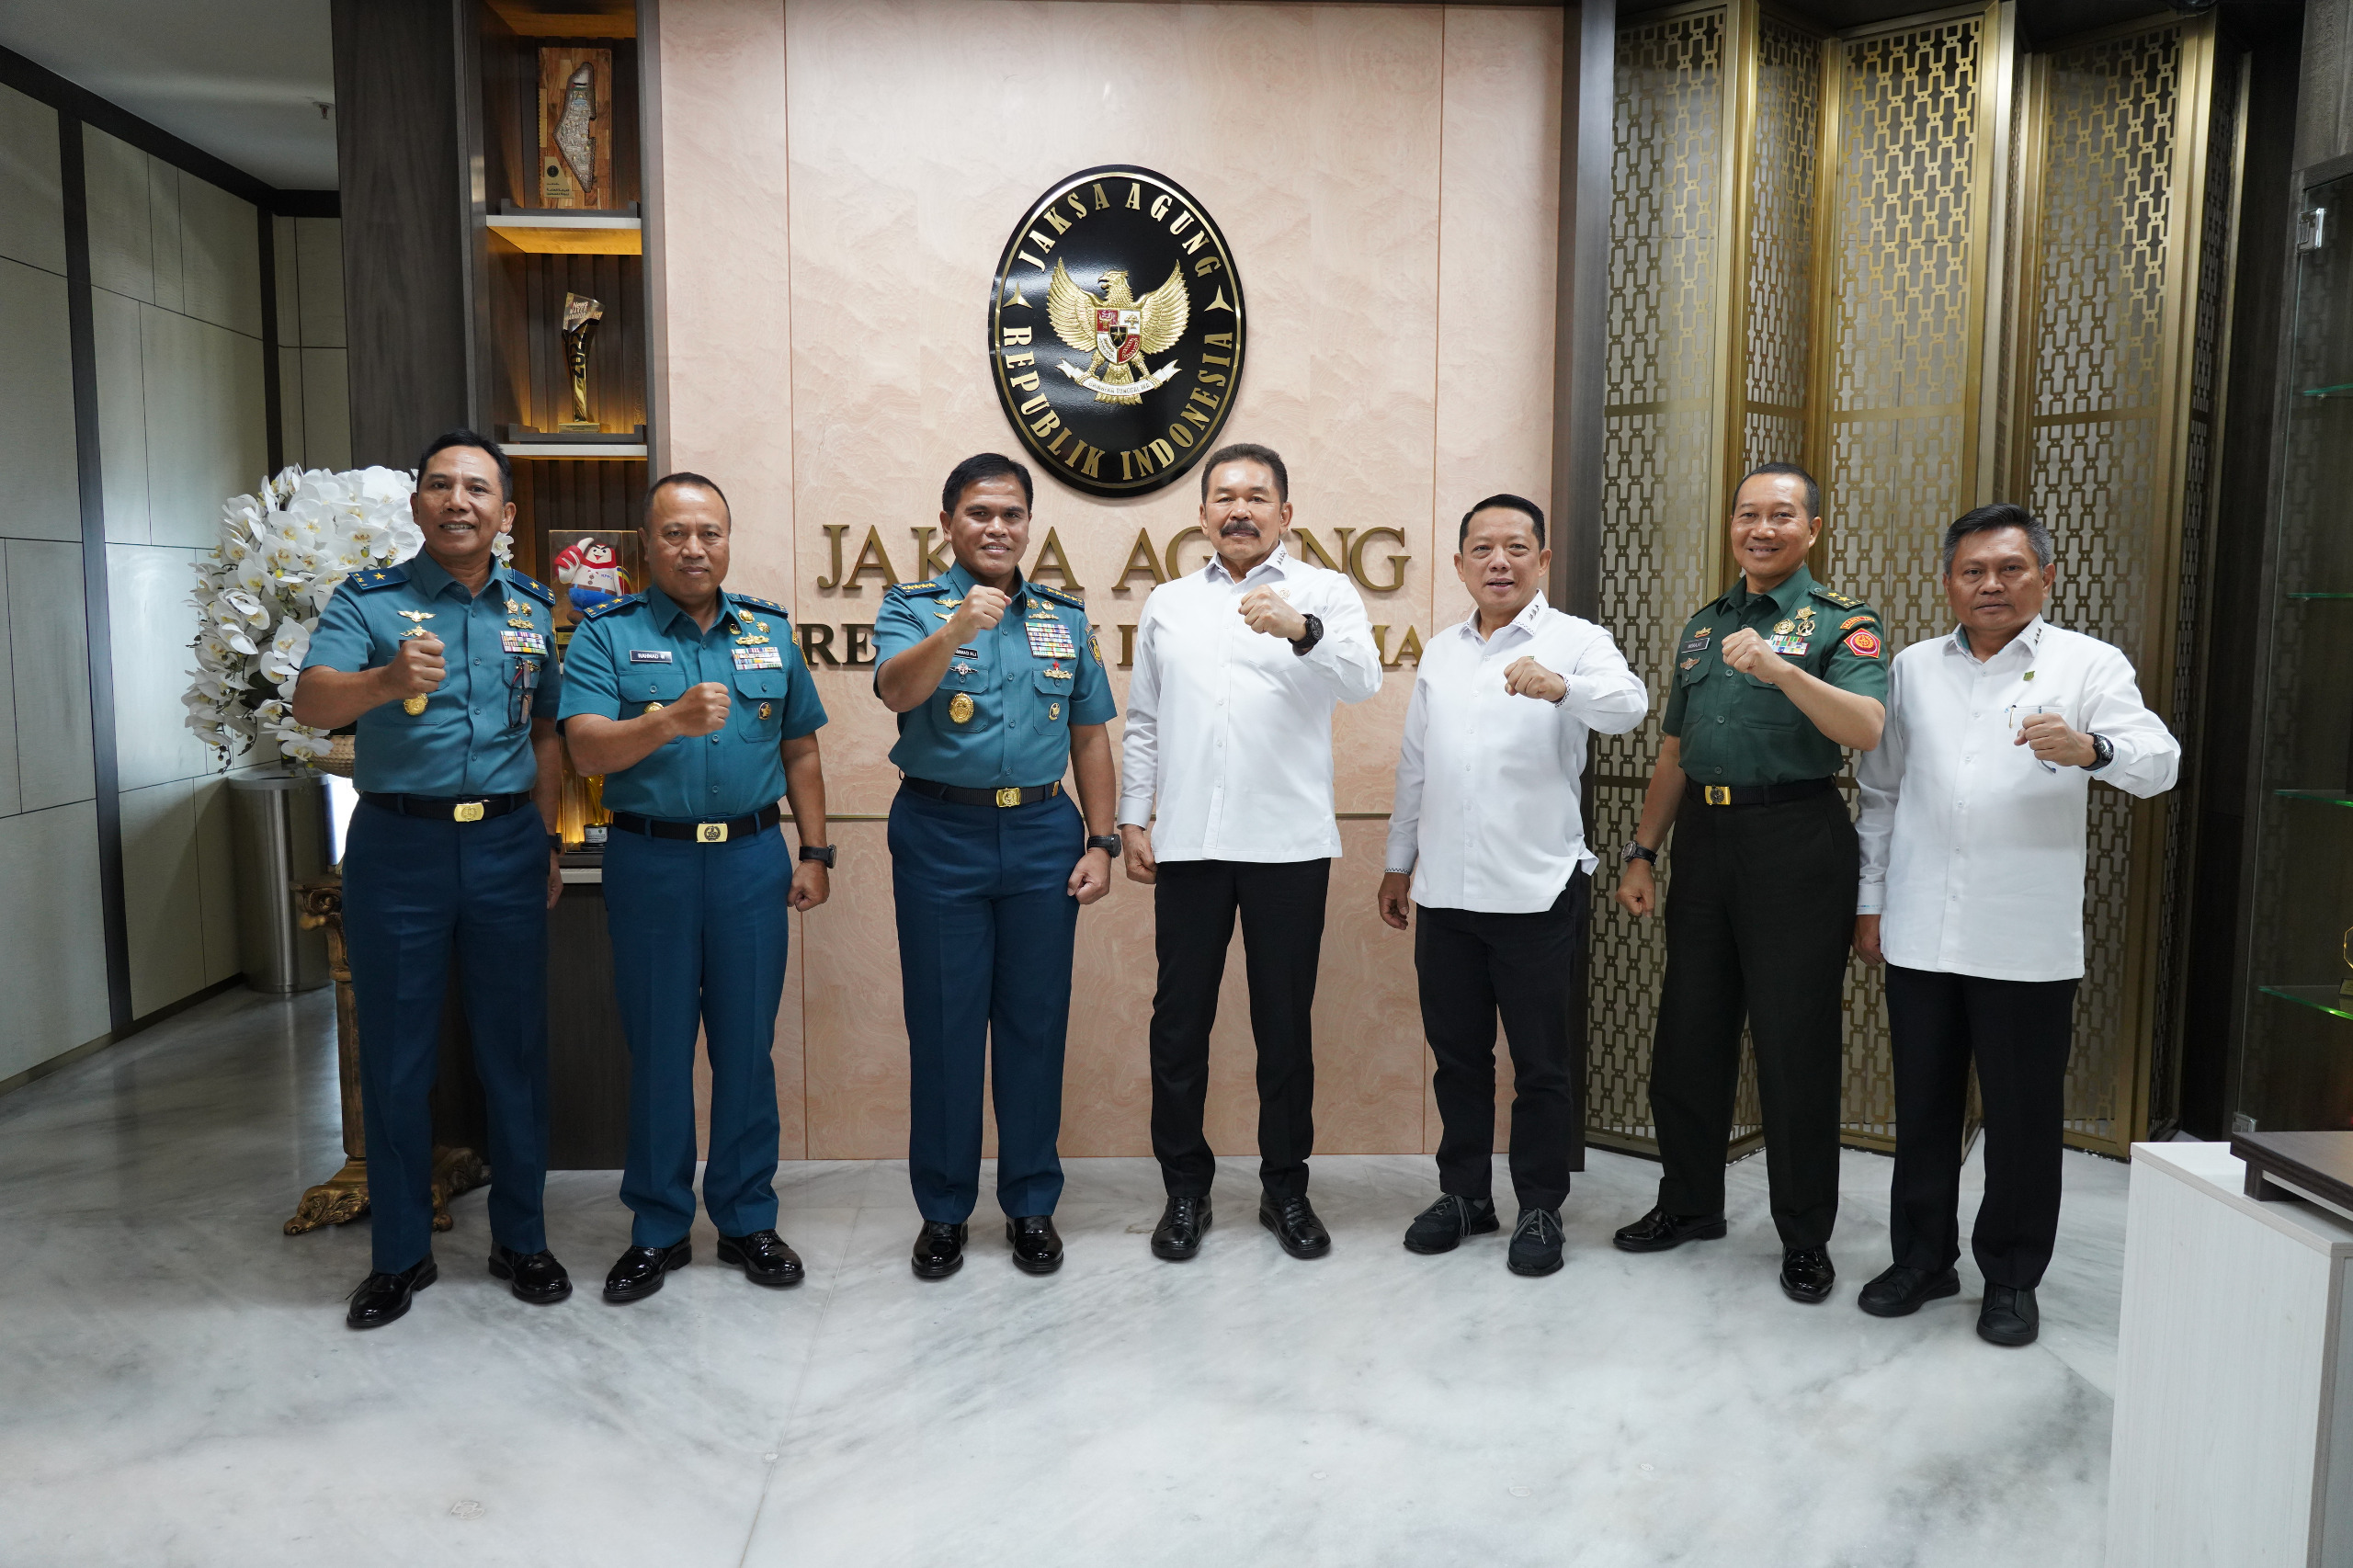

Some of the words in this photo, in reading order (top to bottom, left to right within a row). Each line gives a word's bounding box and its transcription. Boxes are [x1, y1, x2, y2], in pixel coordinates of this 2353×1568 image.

[1017, 183, 1110, 273] JAKSA
[1124, 182, 1222, 278] AGUNG
[1003, 326, 1105, 479] REPUBLIK
[1120, 332, 1233, 481] INDONESIA
[816, 524, 1086, 591] JAKA
[1110, 526, 1412, 591] AGNG
